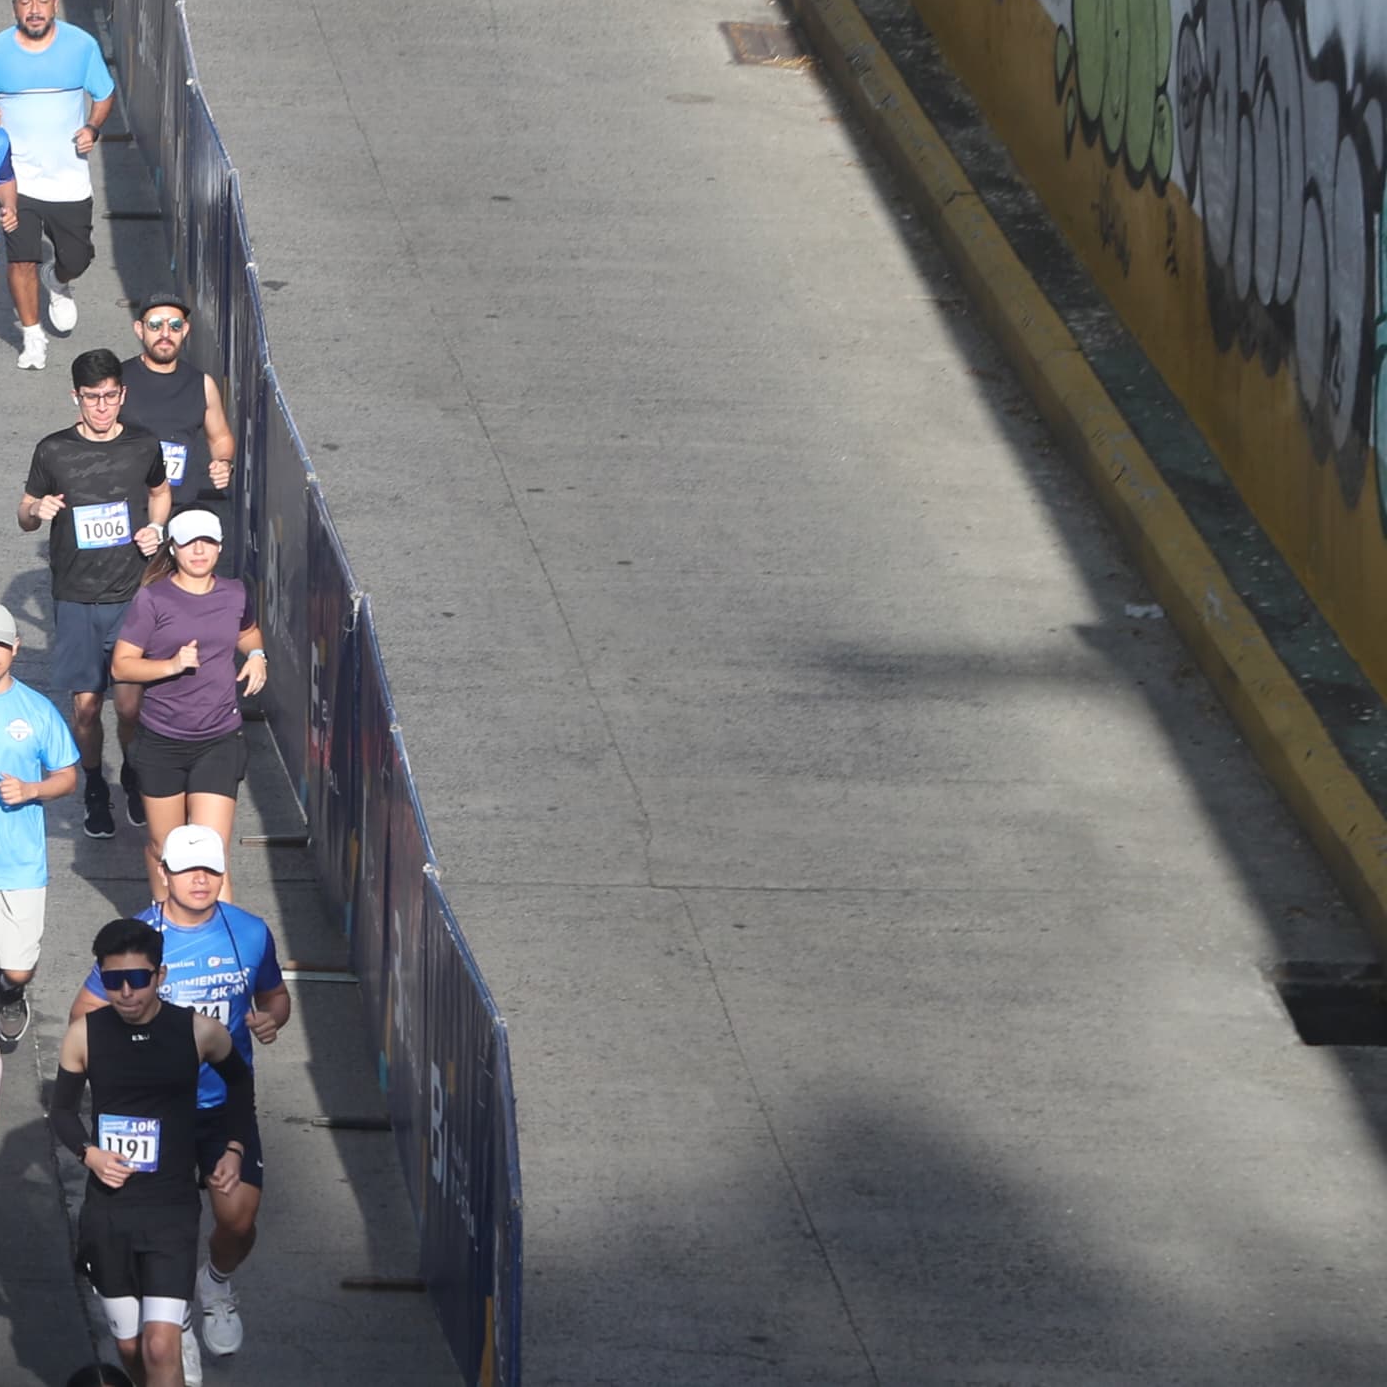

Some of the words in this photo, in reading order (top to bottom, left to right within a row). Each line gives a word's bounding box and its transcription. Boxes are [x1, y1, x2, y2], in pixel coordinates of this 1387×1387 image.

[82, 520, 125, 539] 1006
[129, 1119, 157, 1133] 10K
[104, 1134, 150, 1162] 1191
